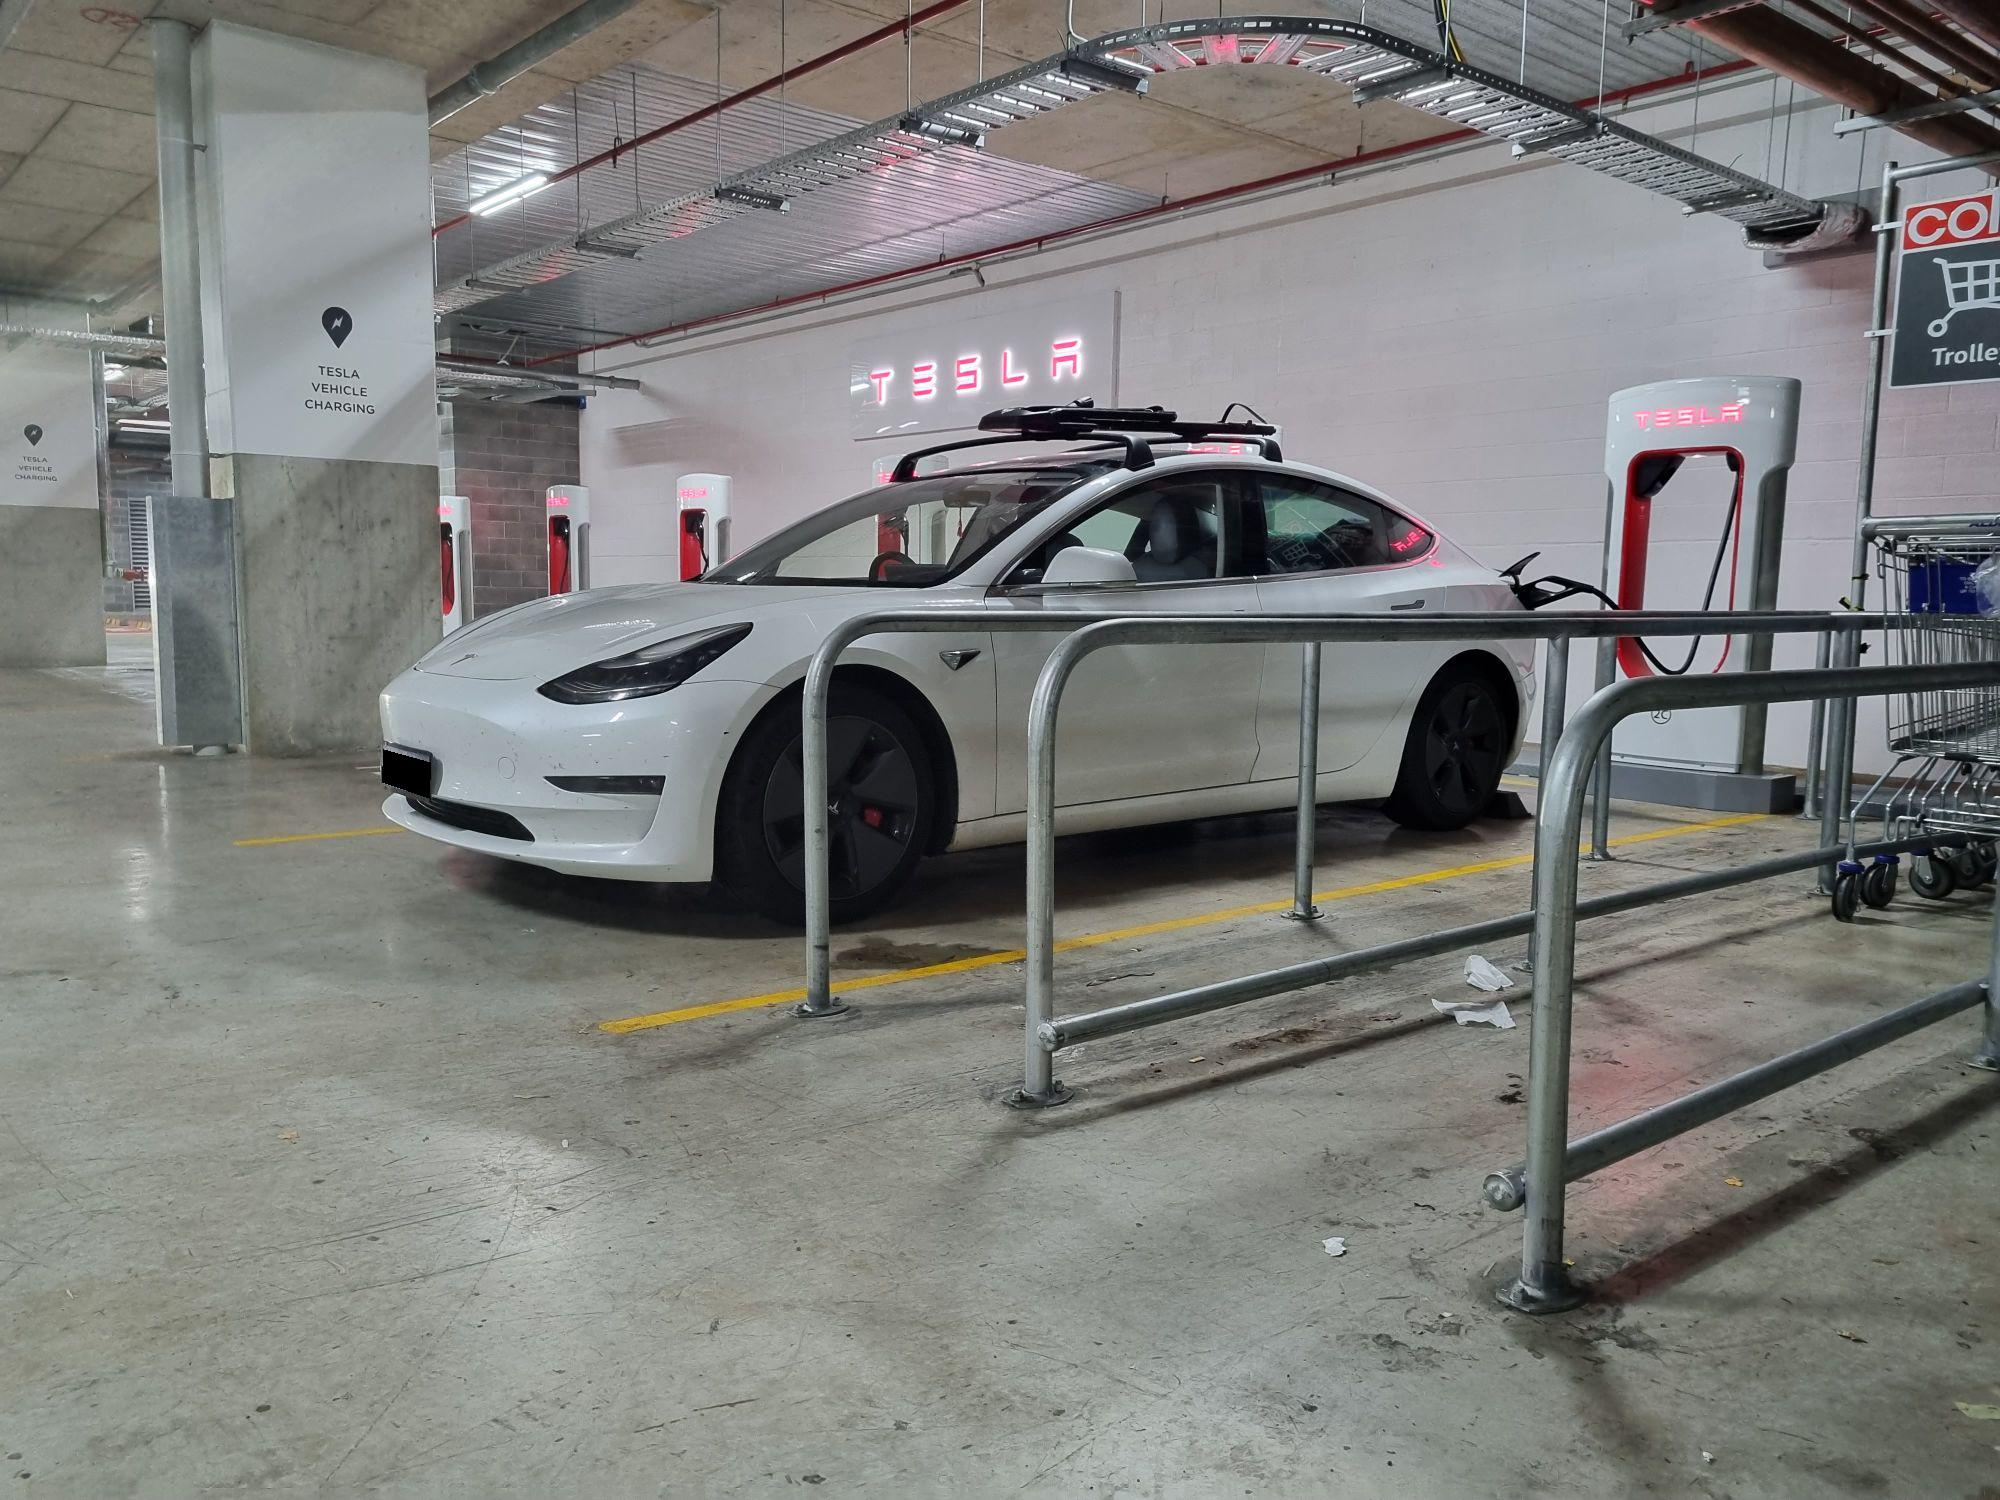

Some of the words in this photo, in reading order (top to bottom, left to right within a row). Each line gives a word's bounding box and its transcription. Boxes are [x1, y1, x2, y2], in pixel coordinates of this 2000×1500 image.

[1932, 342, 2000, 366] Trolle
[318, 365, 360, 379] TESLA
[868, 339, 1081, 405] TESLA
[311, 382, 368, 397] VEHICLE
[304, 399, 375, 415] CHARGING
[1633, 404, 1741, 429] TESLA
[22, 455, 49, 463] TESLA
